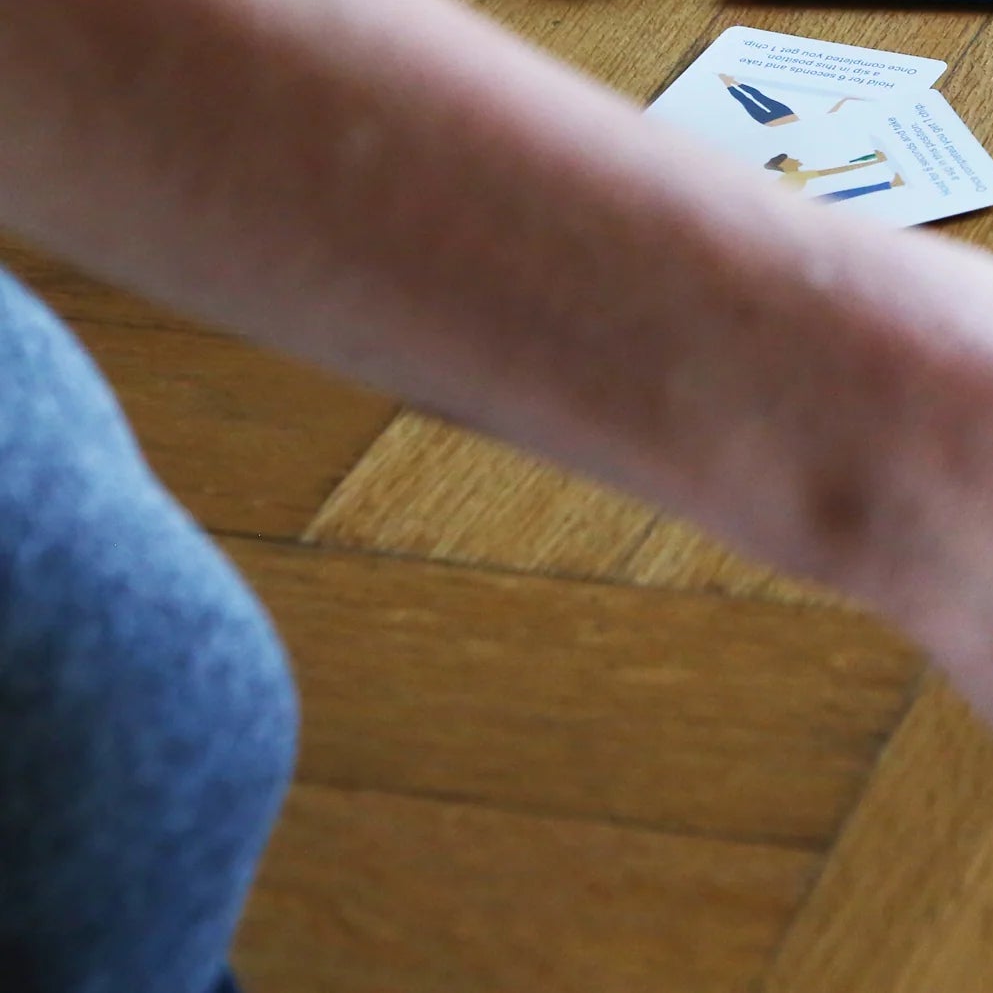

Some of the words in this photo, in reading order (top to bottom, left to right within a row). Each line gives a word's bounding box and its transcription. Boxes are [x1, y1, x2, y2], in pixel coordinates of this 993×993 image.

[802, 51, 823, 59] you
[739, 57, 763, 67] take
[816, 61, 838, 70] this
[825, 54, 885, 69] completed
[766, 62, 788, 71] and
[853, 67, 871, 75] sip
[889, 65, 918, 75] Once
[790, 66, 836, 79] seconds
[849, 77, 866, 85] for
[868, 79, 895, 89] Hold
